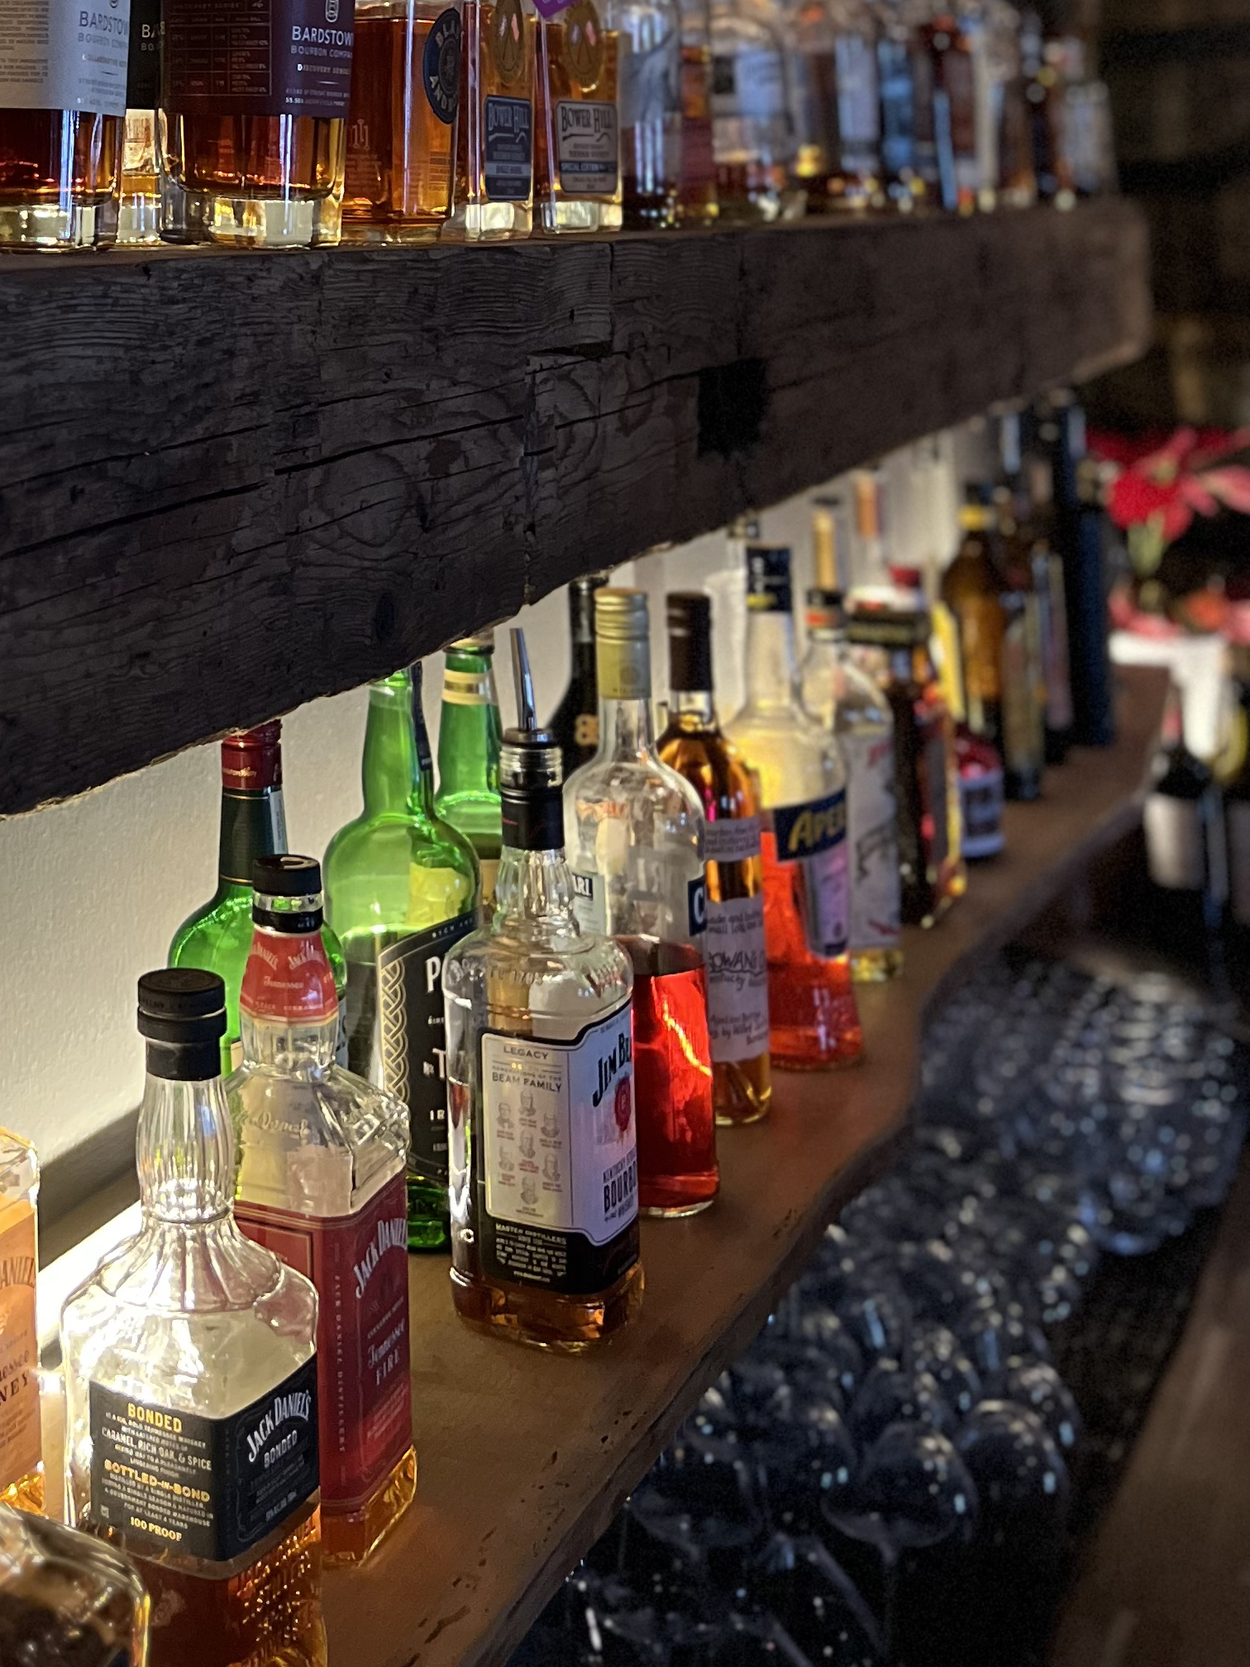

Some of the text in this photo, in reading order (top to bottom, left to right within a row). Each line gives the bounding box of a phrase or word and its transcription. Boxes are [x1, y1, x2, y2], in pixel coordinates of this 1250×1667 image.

[79, 11, 129, 35] BARDSTOW
[291, 26, 354, 47] BARDSTOW
[290, 45, 327, 56] BOURBON
[561, 106, 613, 133] BOWER HILL
[288, 950, 307, 970] JACK
[709, 973, 746, 992] entucky
[503, 1045, 549, 1060] LEGACY
[492, 1072, 562, 1093] BEAM FAMILY
[593, 1047, 617, 1108] JIM
[604, 1161, 637, 1213] BOURB
[495, 1223, 567, 1245] MASTER DISTILLERS
[354, 1242, 380, 1299] JACK
[375, 1348, 402, 1386] FIRE
[128, 1403, 183, 1433] BONDED
[247, 1390, 312, 1463] JACK DANIEL'S
[102, 1427, 212, 1471] CARAMEL, RICH OAK, & SPICE
[178, 1436, 206, 1449] WHISKEY
[264, 1430, 298, 1469] BONDED
[104, 1459, 211, 1502] BOTTLED-IN-BOND
[130, 1516, 183, 1542] 100 PROOF
